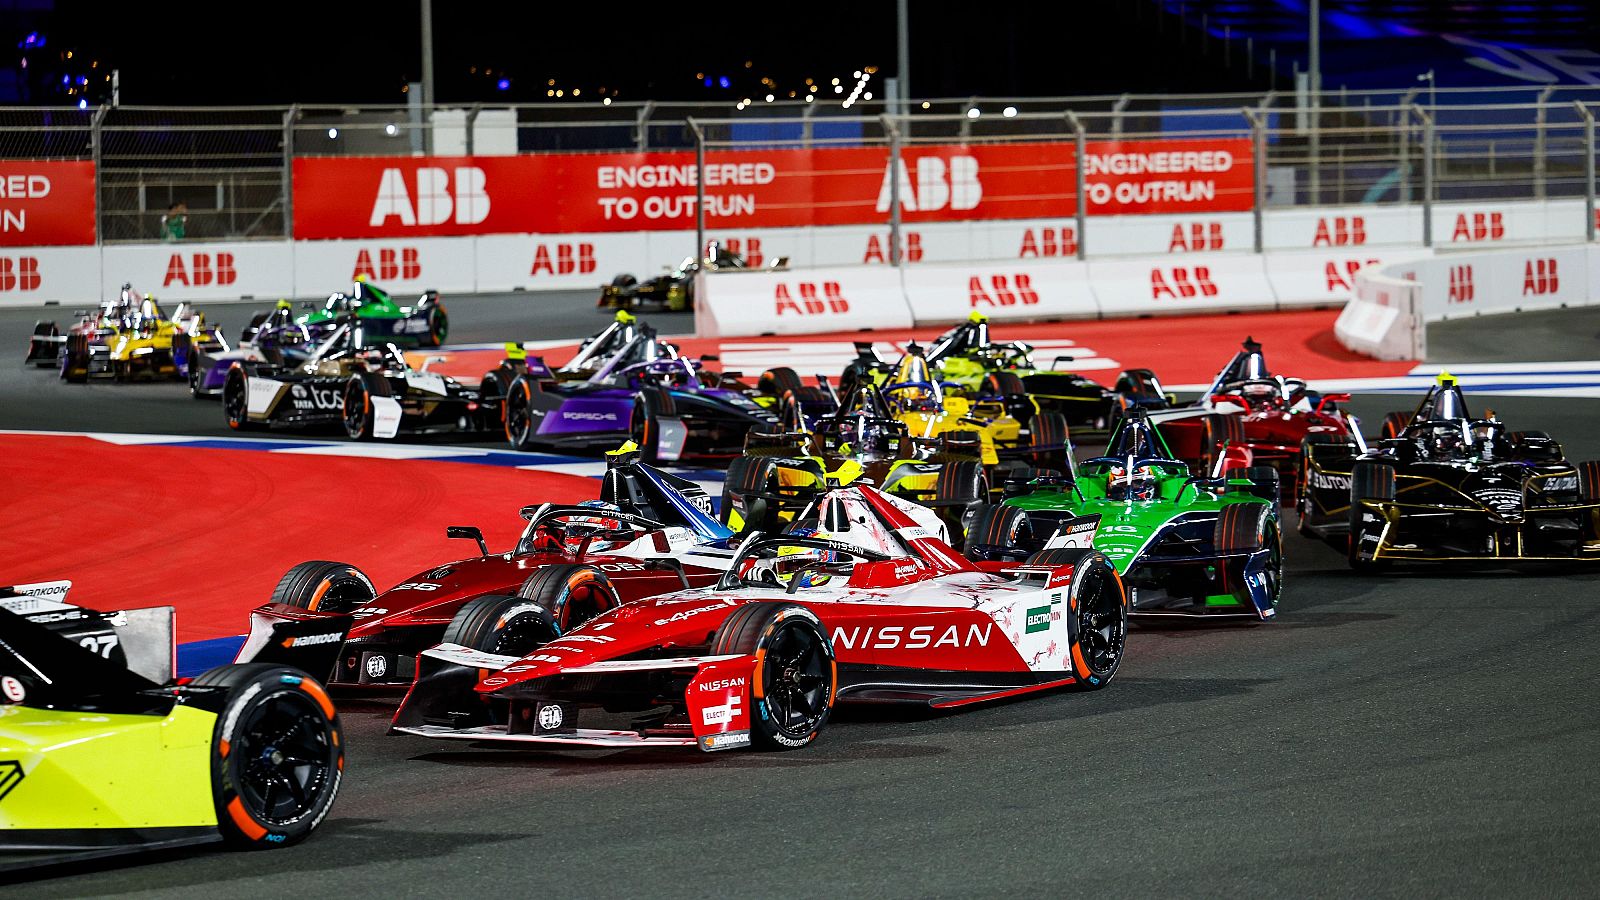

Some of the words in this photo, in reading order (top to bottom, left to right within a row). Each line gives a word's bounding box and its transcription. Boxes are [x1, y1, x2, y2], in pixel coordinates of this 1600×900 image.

[597, 163, 775, 188] ENGINEERED
[876, 155, 983, 212] ABB
[369, 167, 491, 227] ABB
[598, 197, 639, 220] TO
[643, 194, 755, 218] OUTRUN
[1115, 180, 1215, 204] OUTRUN
[1020, 227, 1077, 258] ABB
[1169, 222, 1224, 253] ABB
[1313, 217, 1366, 247] ABB
[1453, 213, 1504, 241] ABB
[0, 256, 41, 292] BB
[163, 252, 237, 288] ABB
[352, 247, 422, 281] ABB
[530, 243, 596, 276] ABB
[968, 274, 1039, 307] ABB
[1151, 266, 1218, 299] ABB
[1449, 264, 1474, 303] ABB
[1523, 258, 1558, 296] ABB
[775, 281, 850, 316] ABB
[293, 400, 315, 409] TATA
[563, 411, 617, 421] PORSCHE
[829, 540, 864, 555] NISSAN
[831, 622, 993, 650] NISSAN
[699, 676, 745, 692] NISSAN
